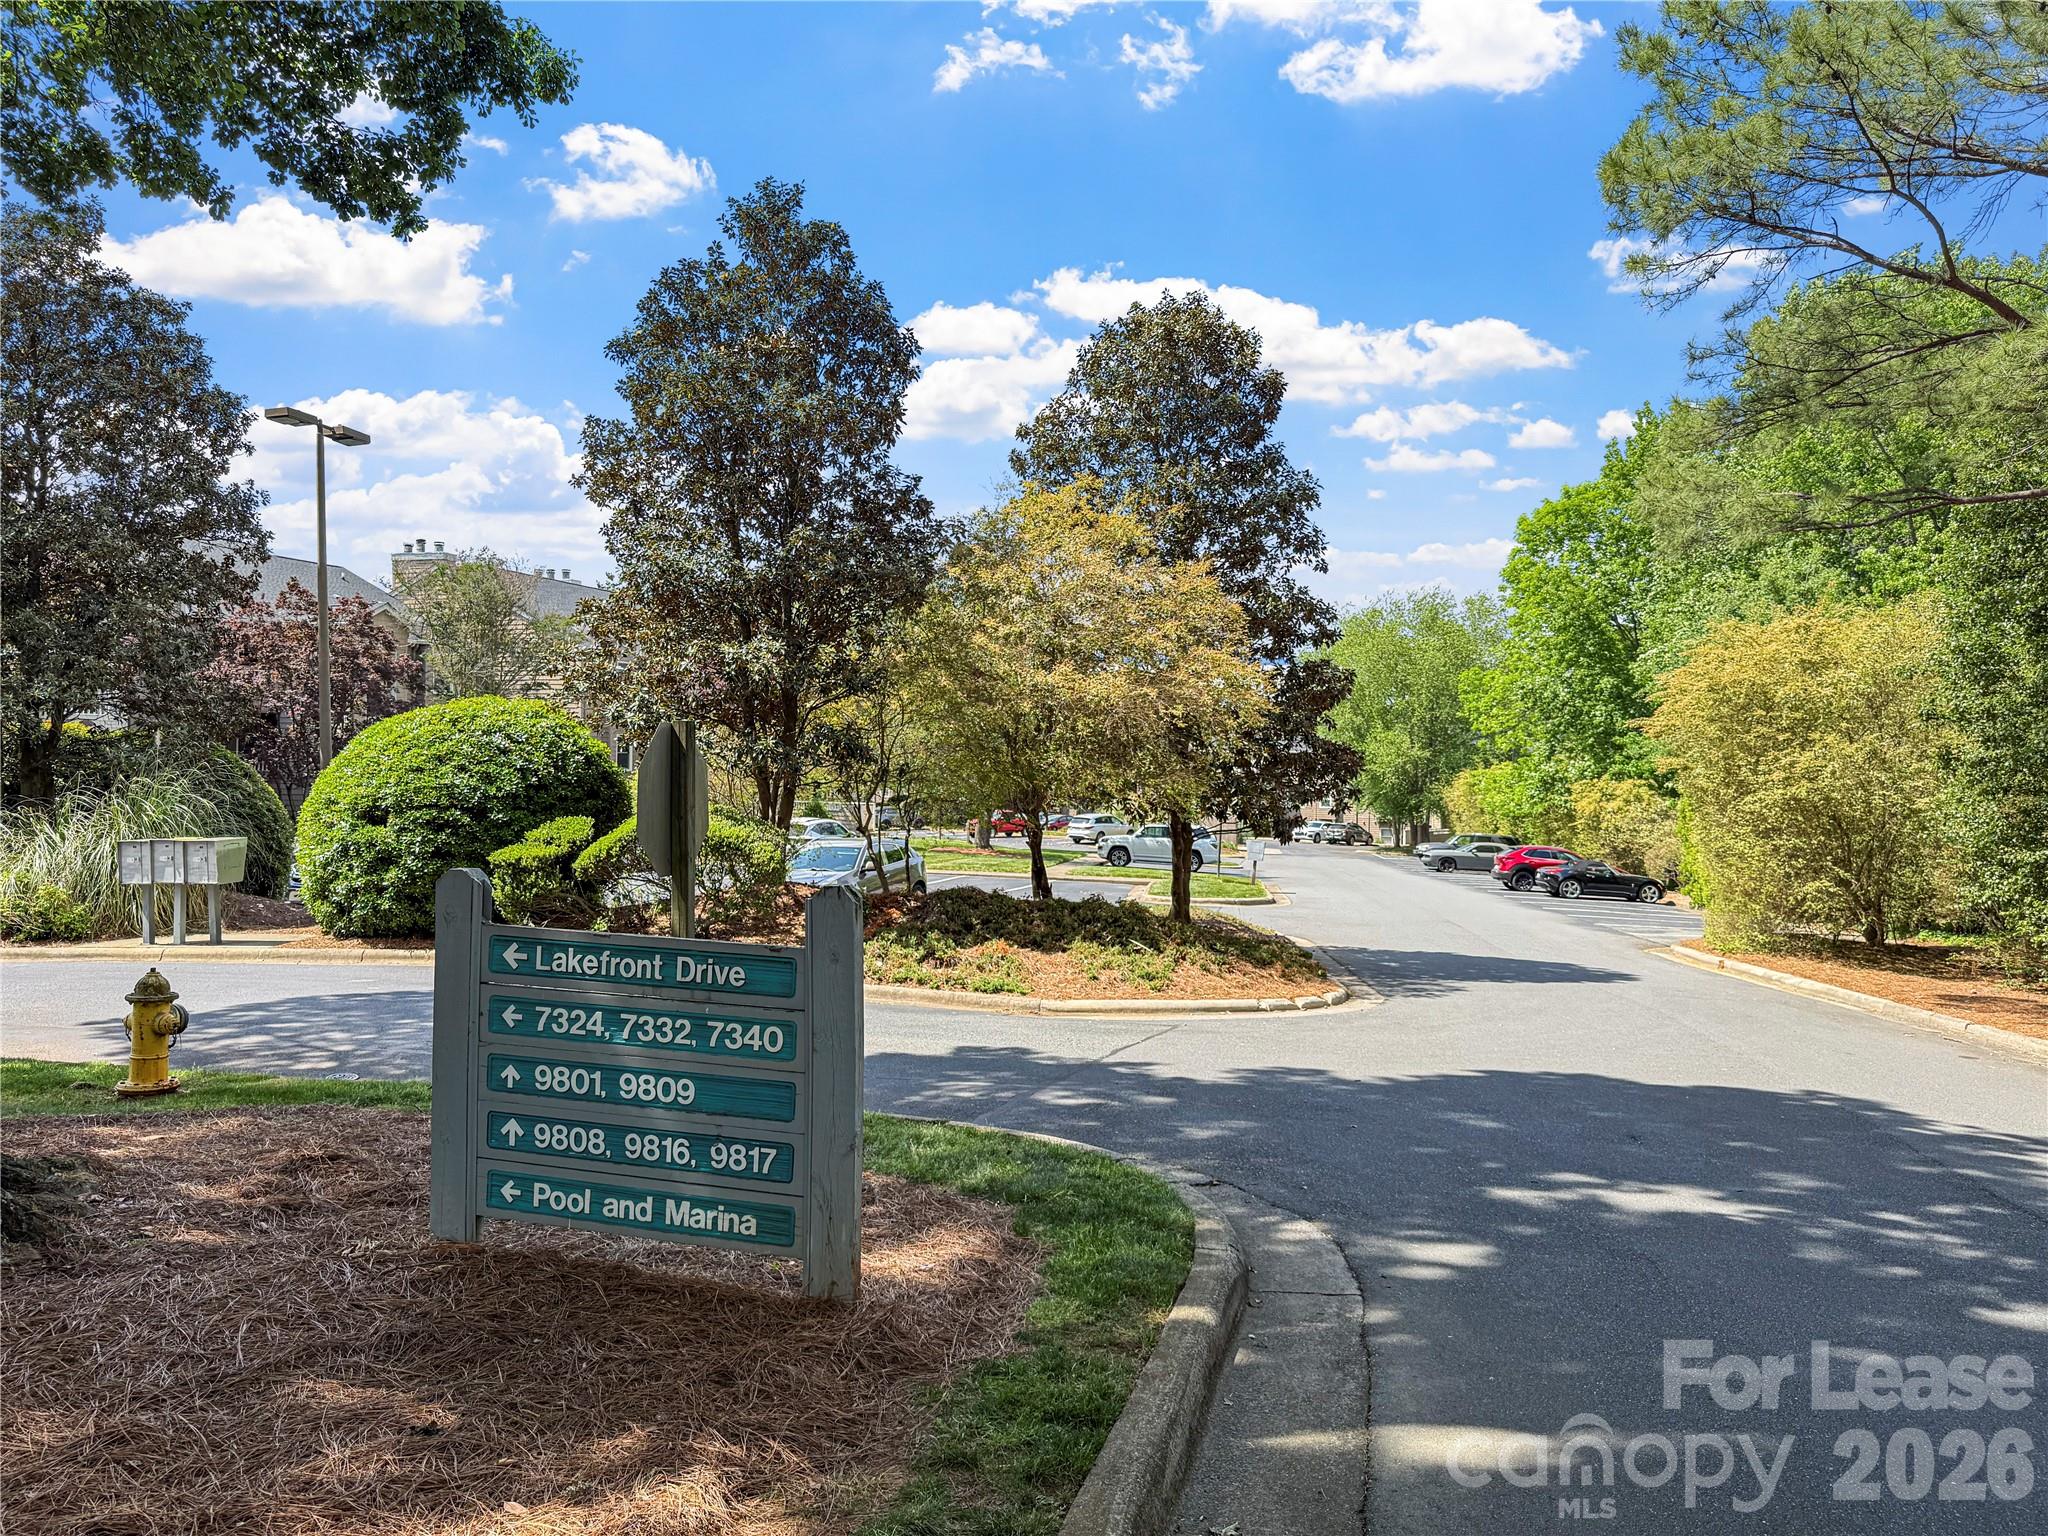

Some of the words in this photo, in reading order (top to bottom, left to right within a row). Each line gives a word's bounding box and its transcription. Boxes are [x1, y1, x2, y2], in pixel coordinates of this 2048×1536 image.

[535, 946, 662, 981] Lakefront
[676, 957, 746, 988] Drive
[535, 1007, 610, 1040] 7324,
[620, 1014, 697, 1047] 7332,
[707, 1021, 783, 1052] 7340
[534, 1065, 606, 1098] 9801,
[619, 1073, 695, 1105] 9809
[534, 1123, 611, 1158] 9808,
[624, 1133, 696, 1167] 9816,
[711, 1143, 777, 1174] 9817
[533, 1183, 591, 1215] Pool
[603, 1196, 652, 1222] and
[665, 1199, 757, 1236] Marina
